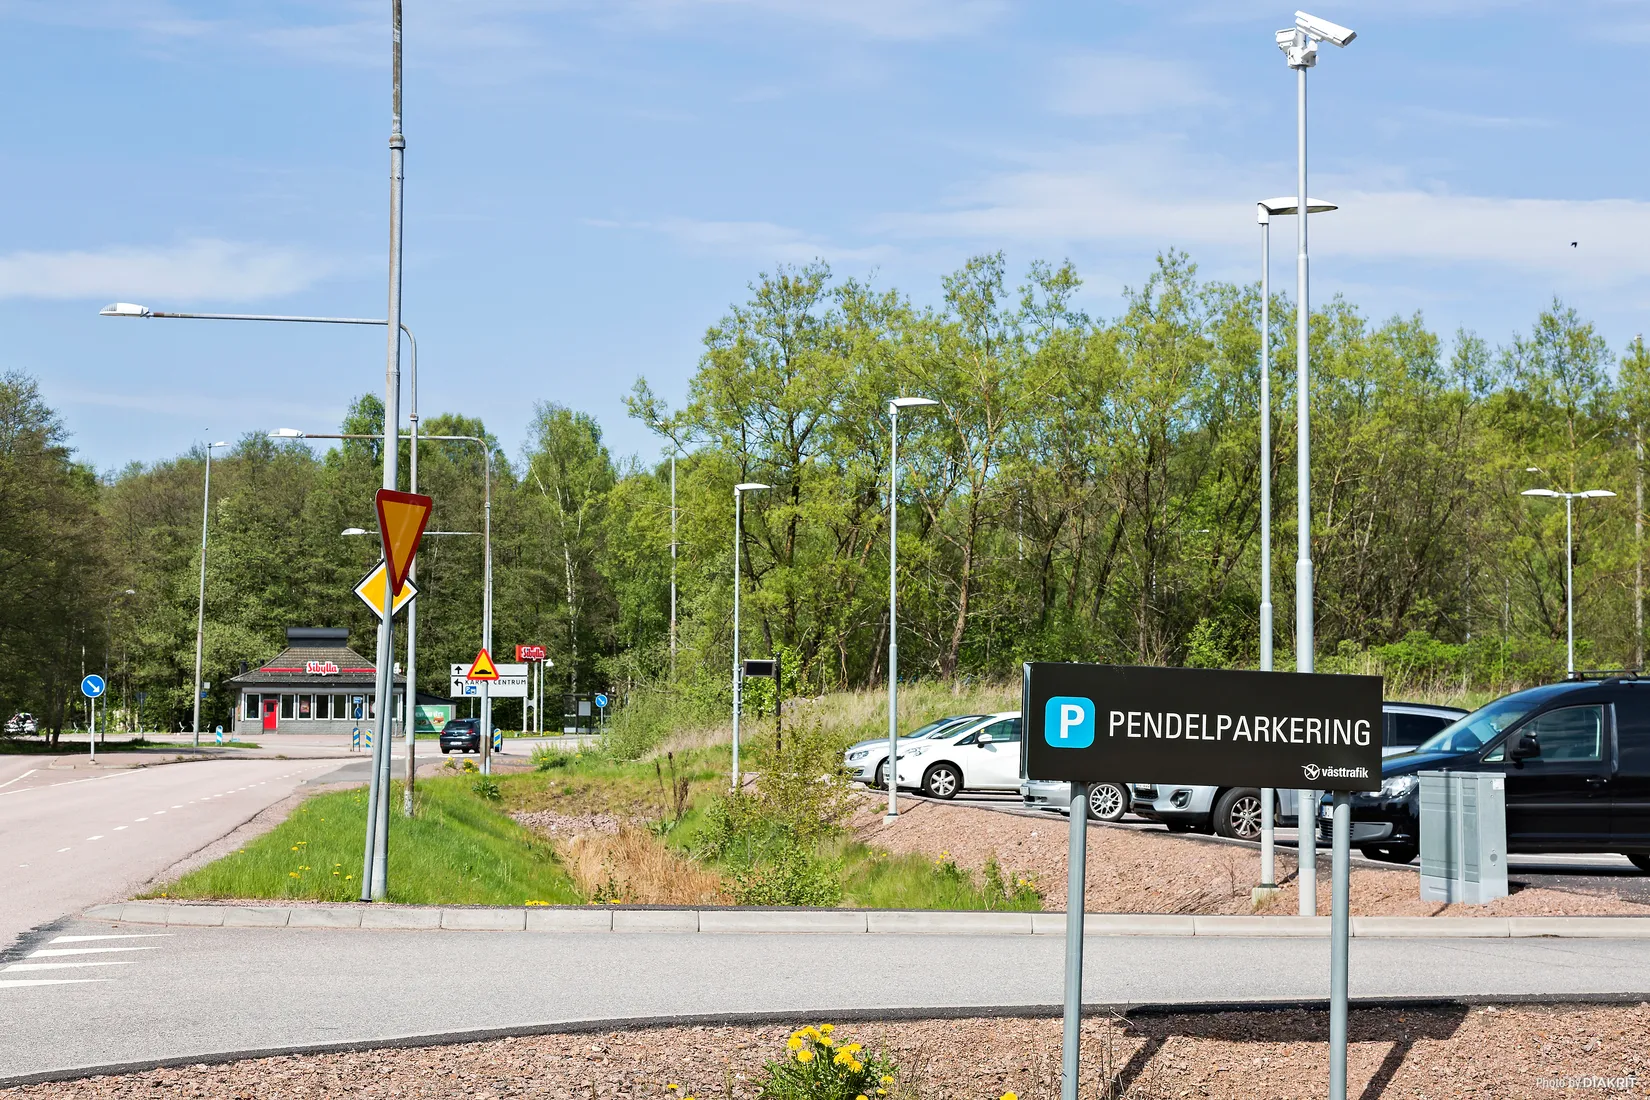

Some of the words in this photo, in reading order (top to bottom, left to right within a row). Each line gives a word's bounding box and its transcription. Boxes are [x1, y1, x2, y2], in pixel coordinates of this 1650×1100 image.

[307, 662, 338, 675] Sibylla
[1059, 704, 1085, 739] P
[1109, 710, 1371, 746] PENDELPARKERING
[1321, 765, 1369, 779] västtrafik
